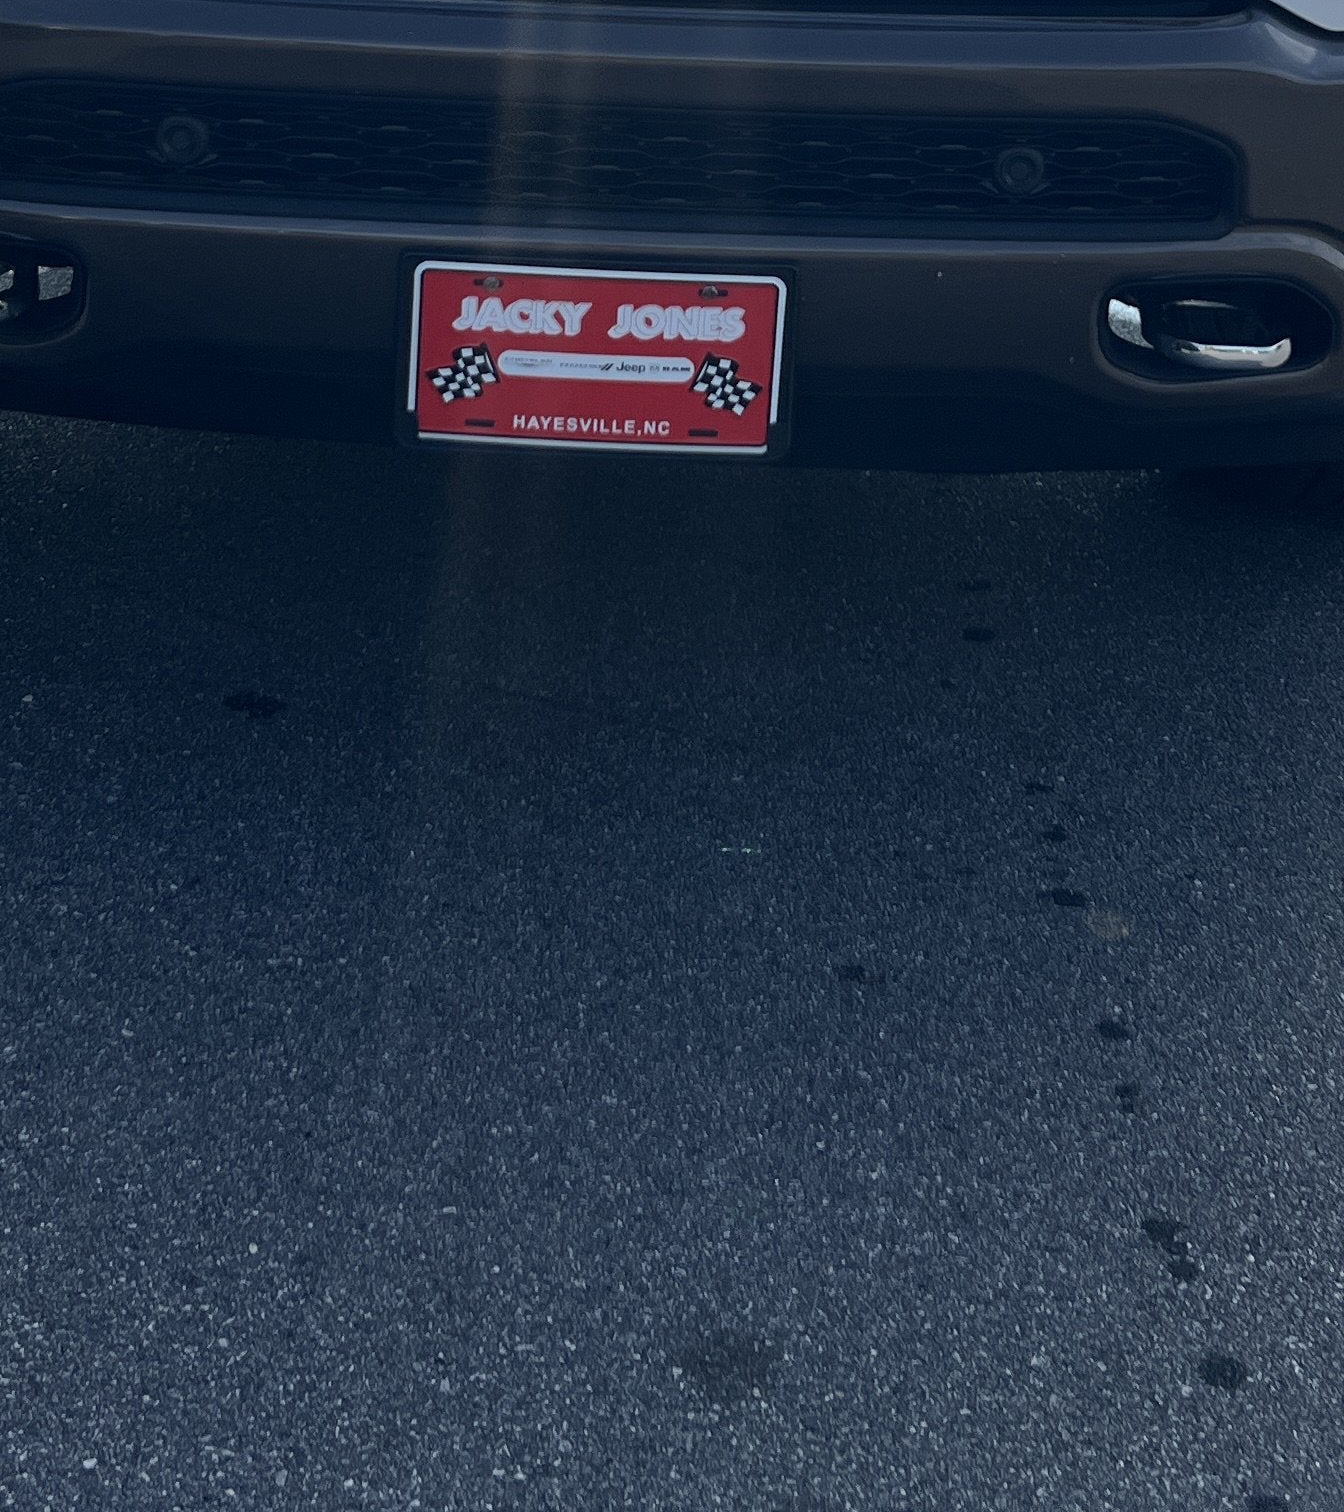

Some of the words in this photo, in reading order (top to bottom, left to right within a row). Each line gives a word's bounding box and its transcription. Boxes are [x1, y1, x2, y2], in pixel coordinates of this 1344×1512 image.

[452, 295, 592, 337] JACKY
[607, 303, 747, 343] JONES
[616, 361, 646, 374] Jeep
